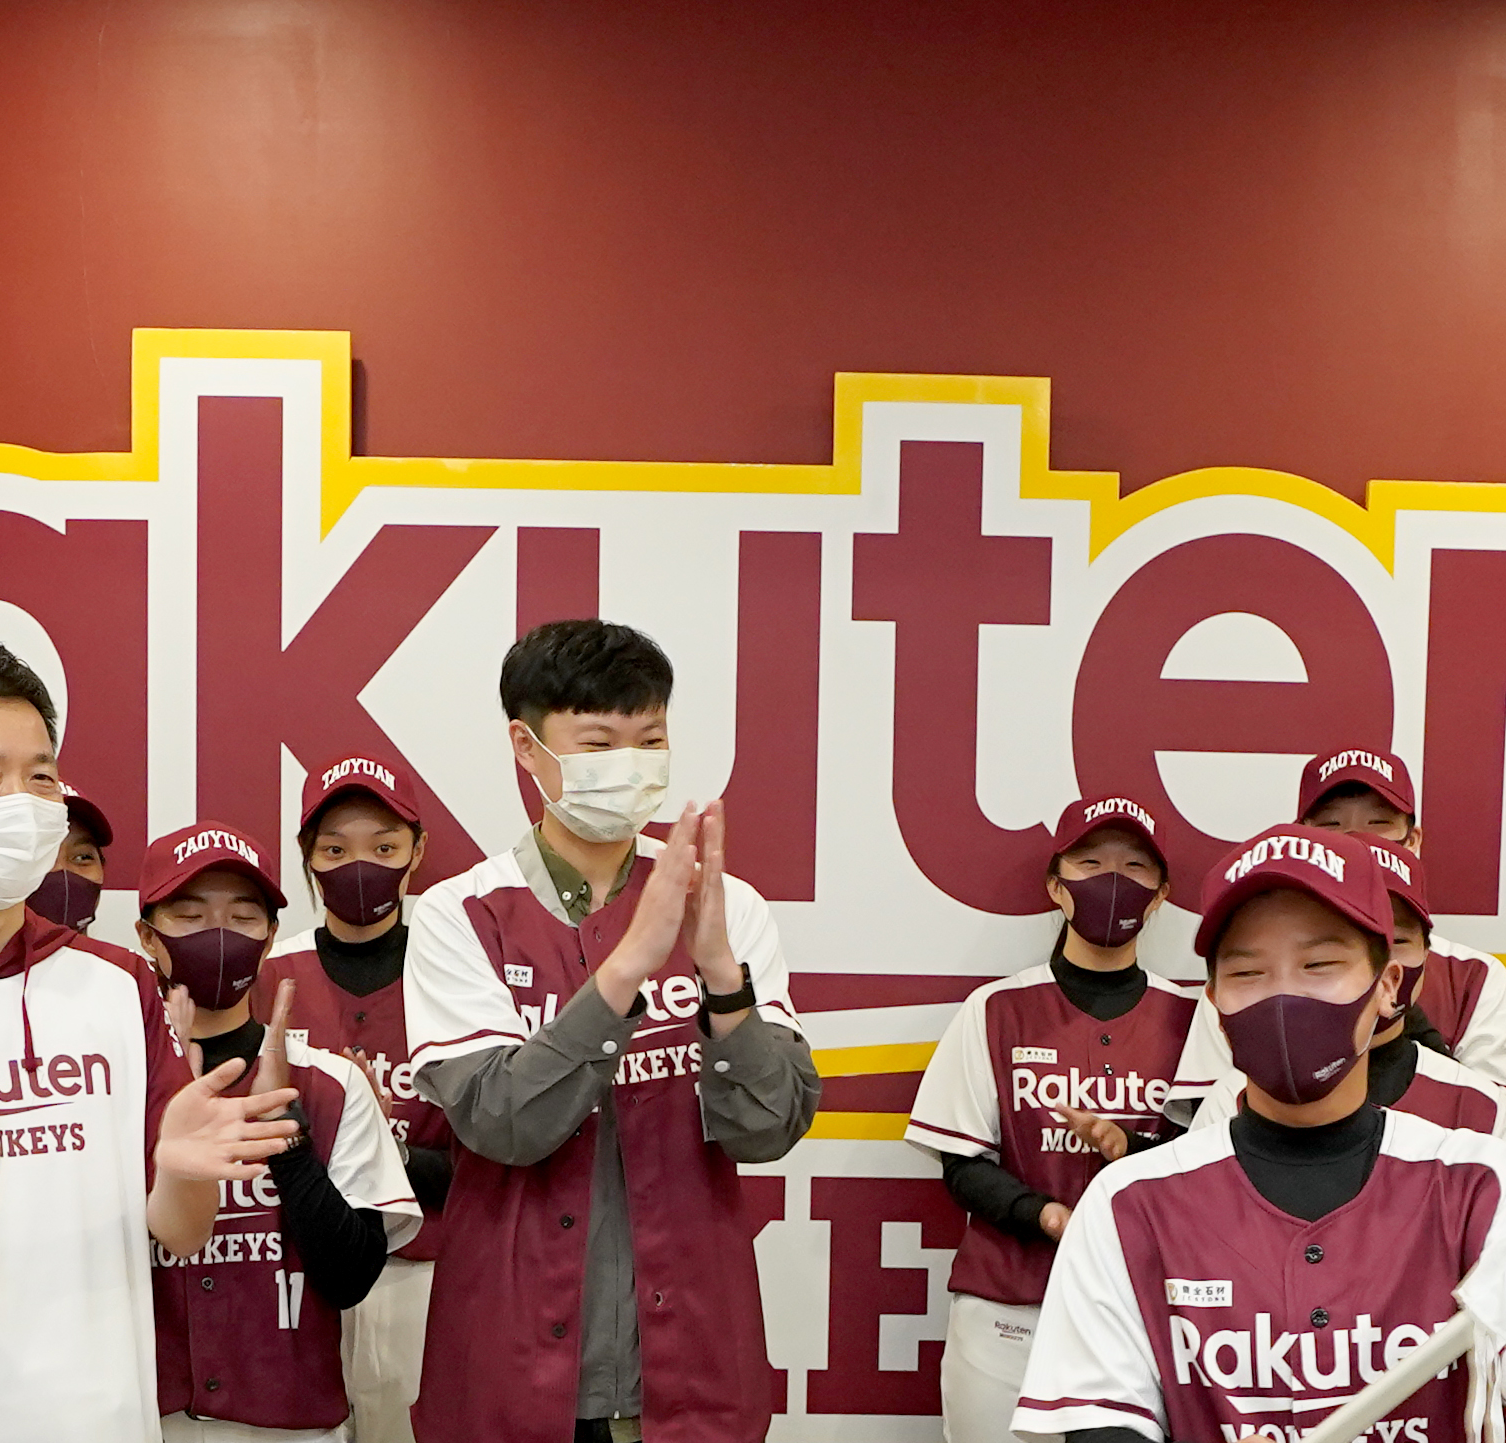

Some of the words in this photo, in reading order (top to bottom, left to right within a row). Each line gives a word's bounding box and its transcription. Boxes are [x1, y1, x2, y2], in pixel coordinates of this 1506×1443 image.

[321, 757, 396, 791] TAOYUAN
[1319, 750, 1394, 782] TAOYUAN
[1084, 797, 1155, 835] TAOYUAN
[174, 829, 260, 868] TAOYUAN
[1224, 835, 1346, 884] TAOYUAN
[611, 1042, 703, 1086] NKEYS
[1012, 1066, 1171, 1113] Rakute
